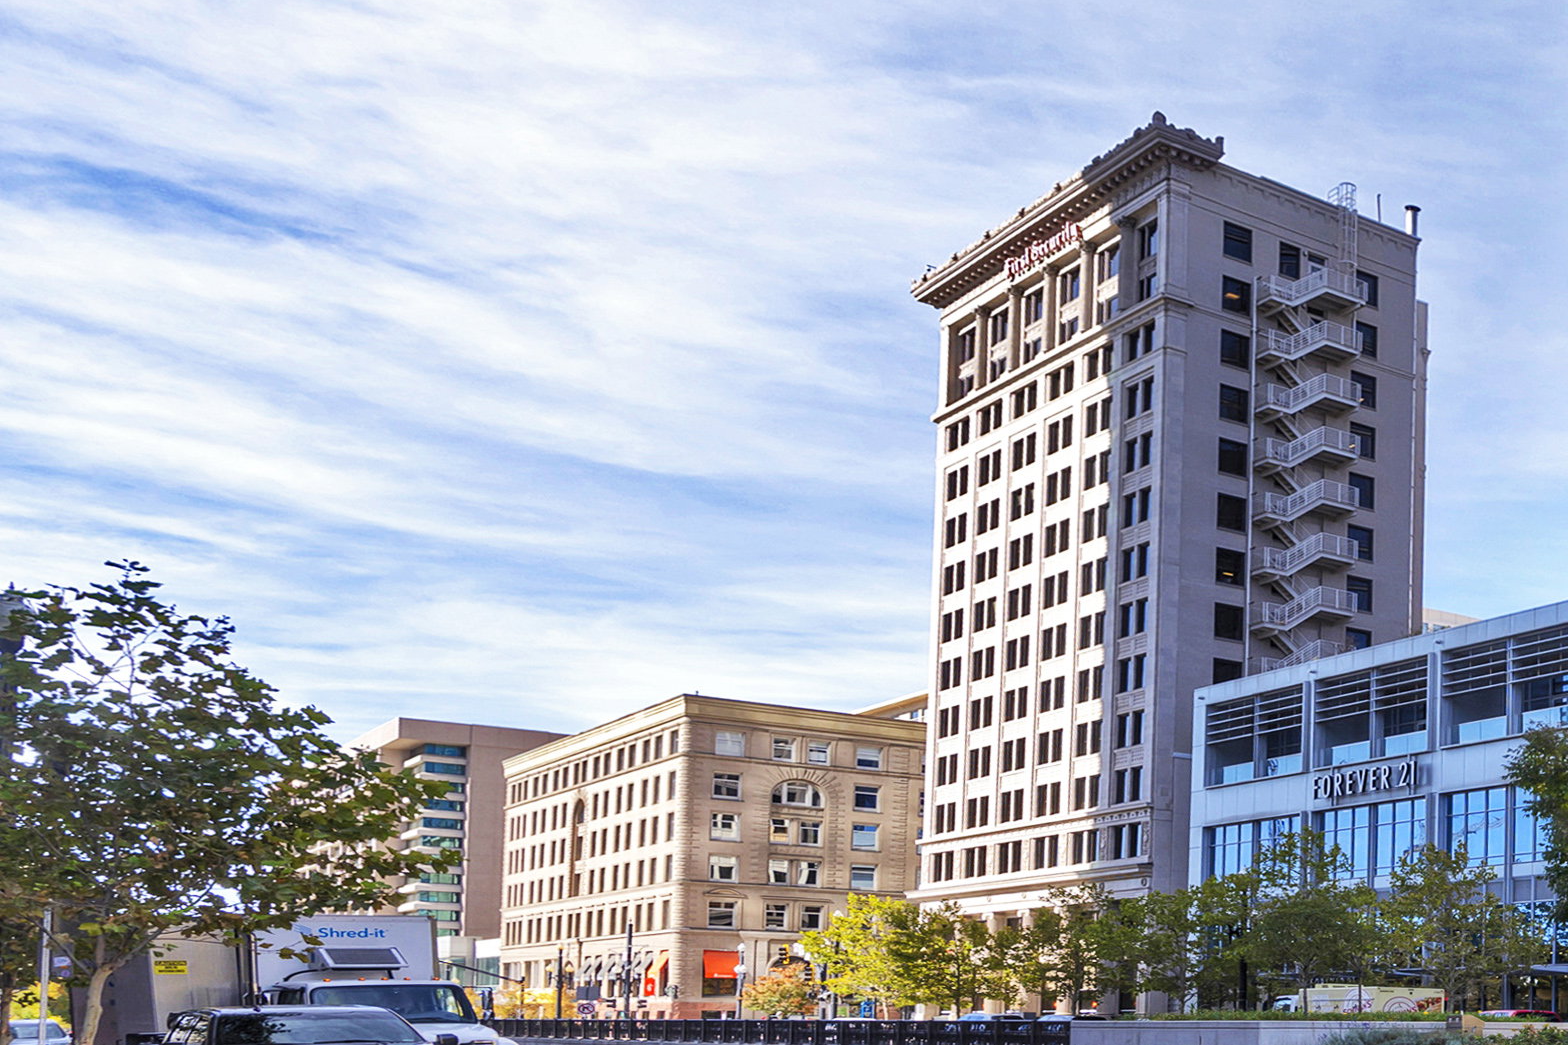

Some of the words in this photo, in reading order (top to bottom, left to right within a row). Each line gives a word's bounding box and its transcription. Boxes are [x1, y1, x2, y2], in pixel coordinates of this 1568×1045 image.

[1312, 765, 1390, 799] FOREVER
[1396, 760, 1416, 788] 21
[318, 927, 385, 939] Shred-it
